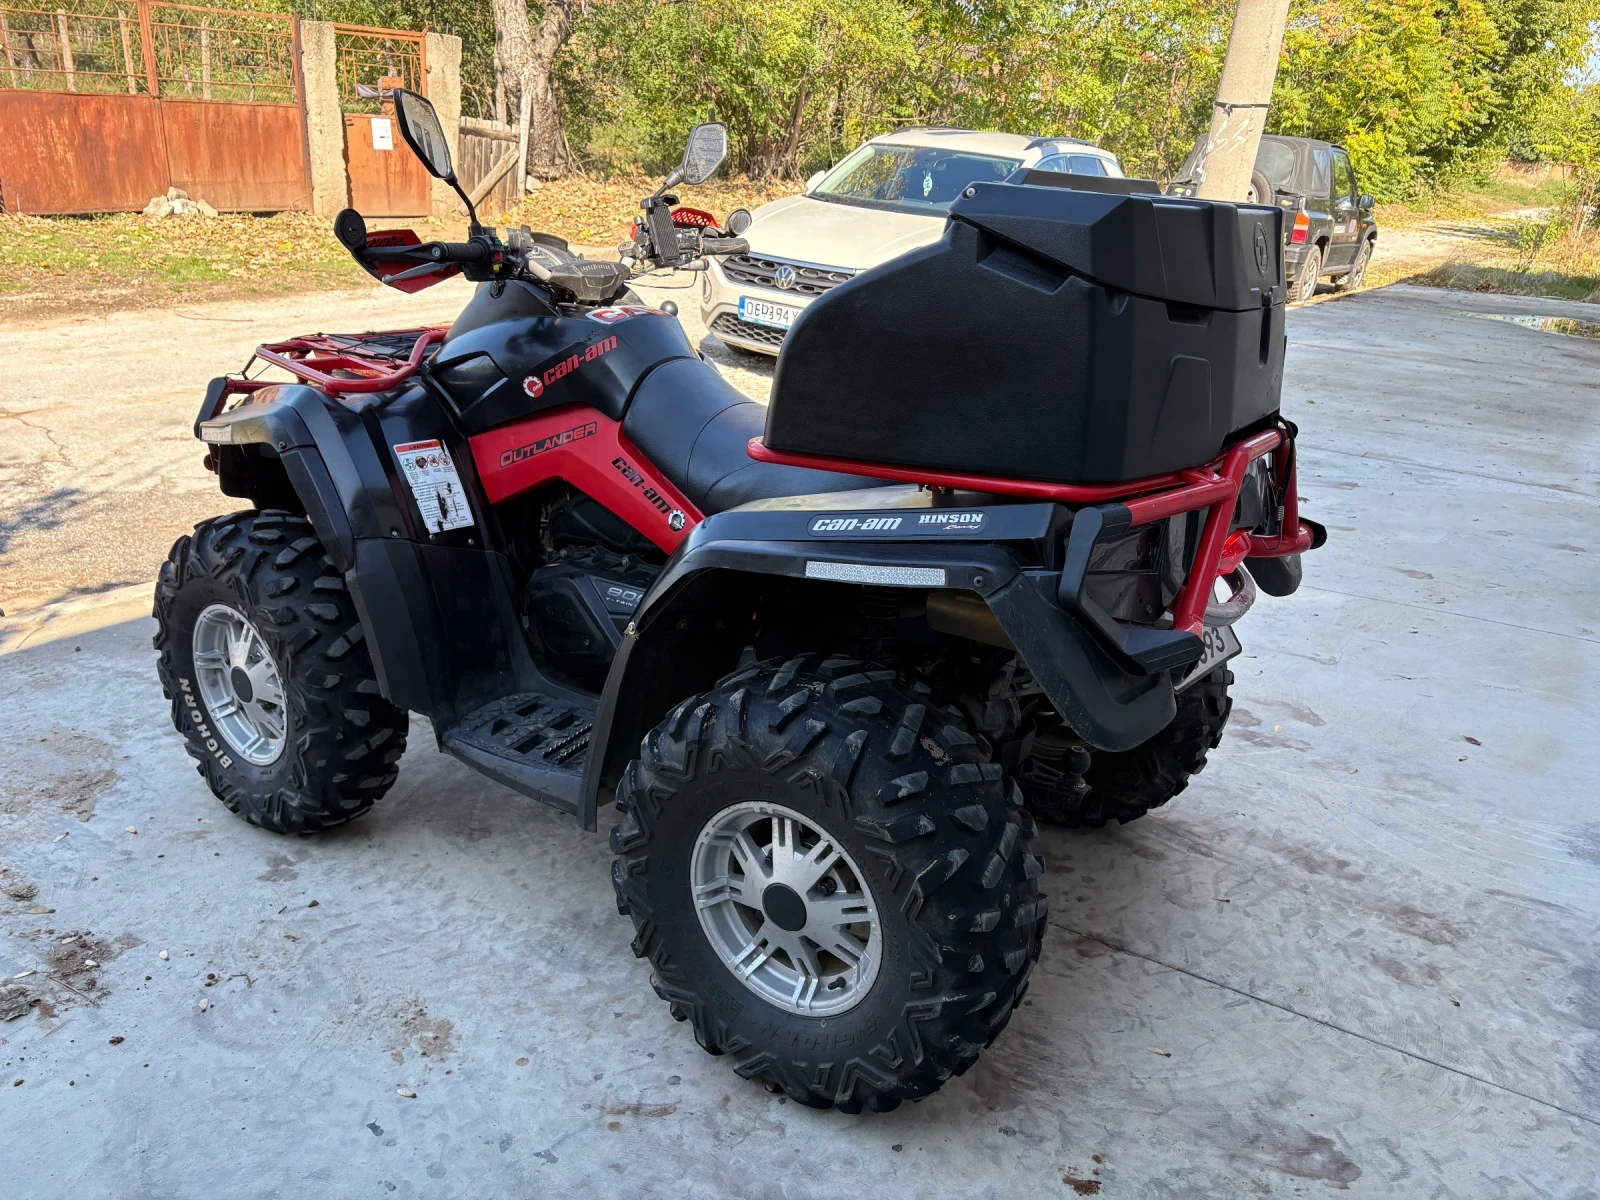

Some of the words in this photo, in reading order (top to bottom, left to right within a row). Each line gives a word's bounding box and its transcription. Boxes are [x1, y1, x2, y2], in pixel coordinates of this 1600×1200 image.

[543, 335, 618, 386] can-am
[612, 456, 671, 514] can-am
[812, 517, 902, 531] can-am
[918, 513, 984, 523] HINSON
[179, 677, 233, 769] BIGHORN
